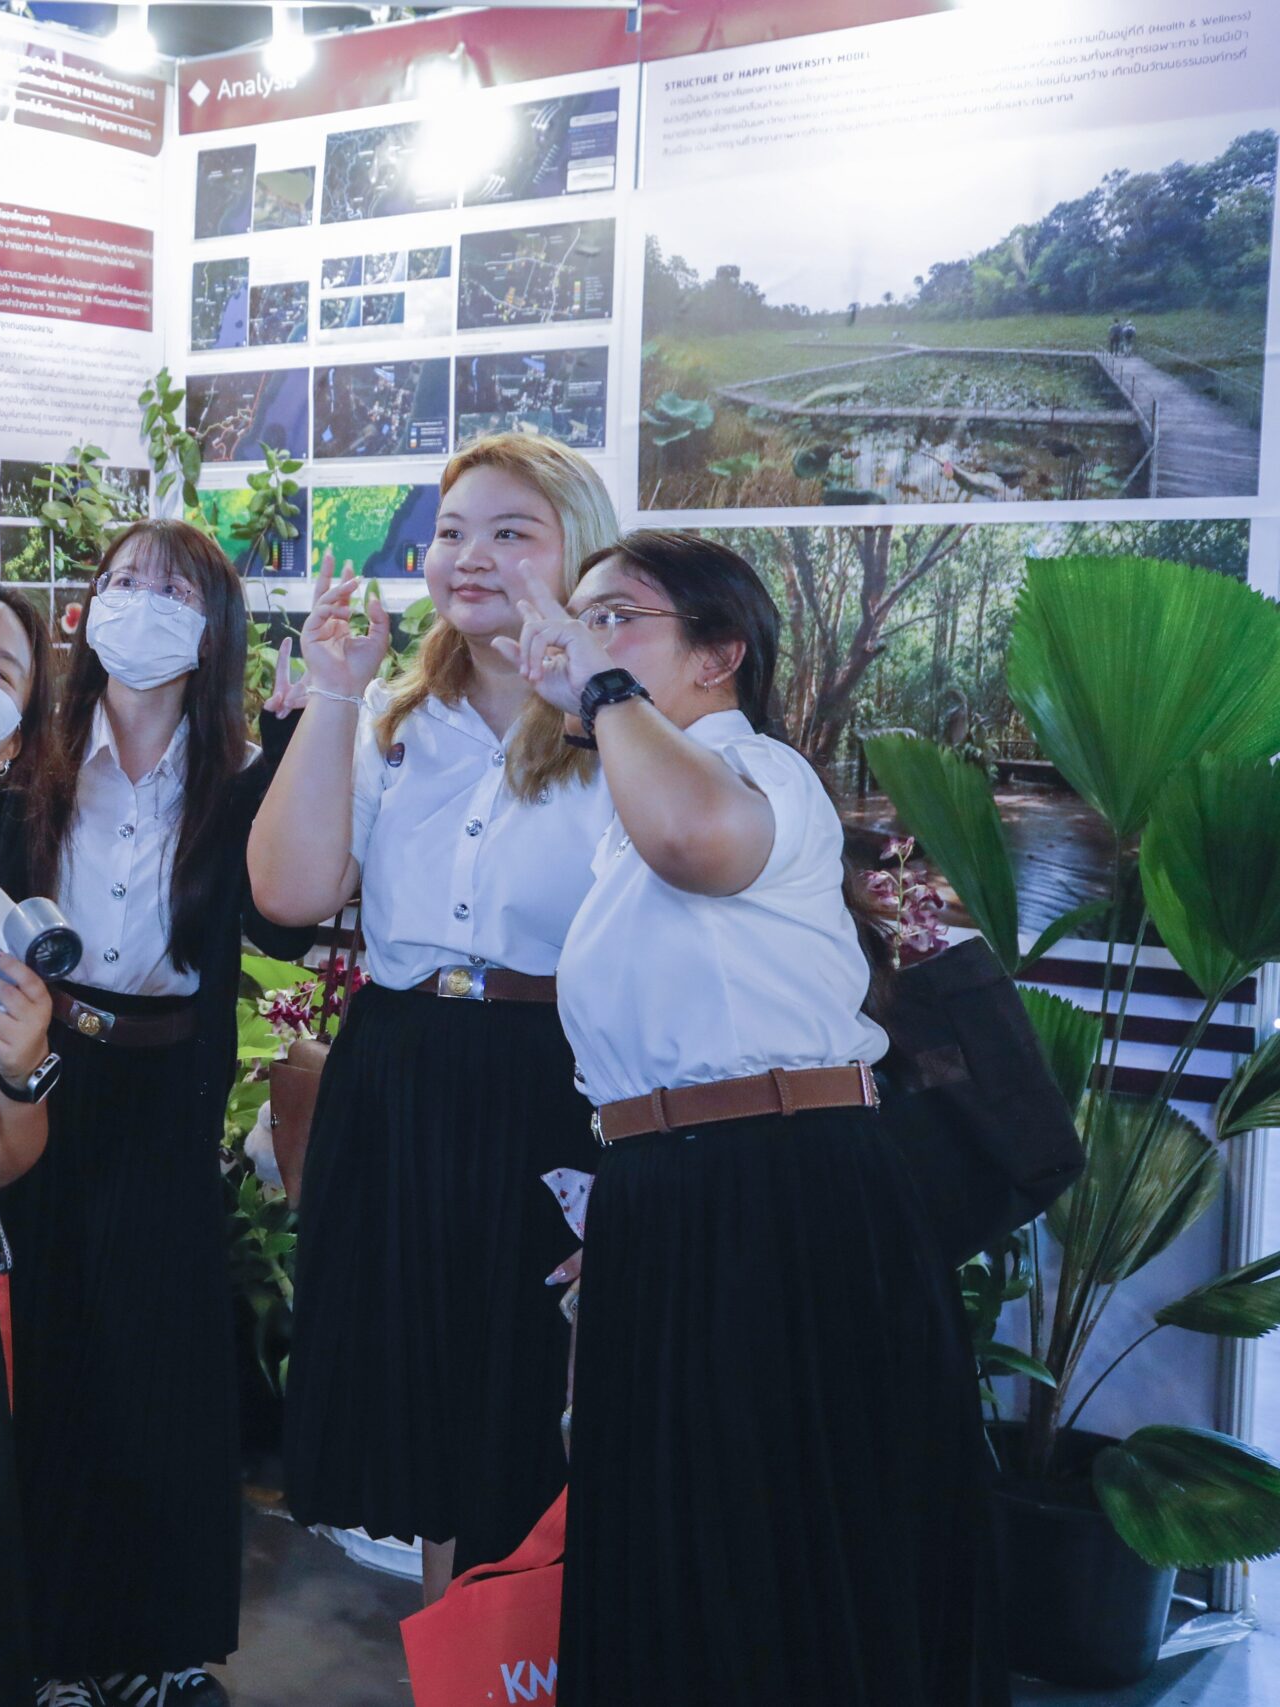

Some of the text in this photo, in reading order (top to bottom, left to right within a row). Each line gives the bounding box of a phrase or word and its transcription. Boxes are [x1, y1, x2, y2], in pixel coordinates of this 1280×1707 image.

[1149, 20, 1185, 36] (Health
[1189, 18, 1197, 28] &
[1202, 10, 1252, 27] Wellness)
[1202, 30, 1250, 46] โดยมีเป้า
[665, 74, 718, 92] STRUCTURE
[723, 70, 734, 82] OF
[738, 65, 771, 80] HAPPY
[775, 56, 833, 74] UNIVERSITY
